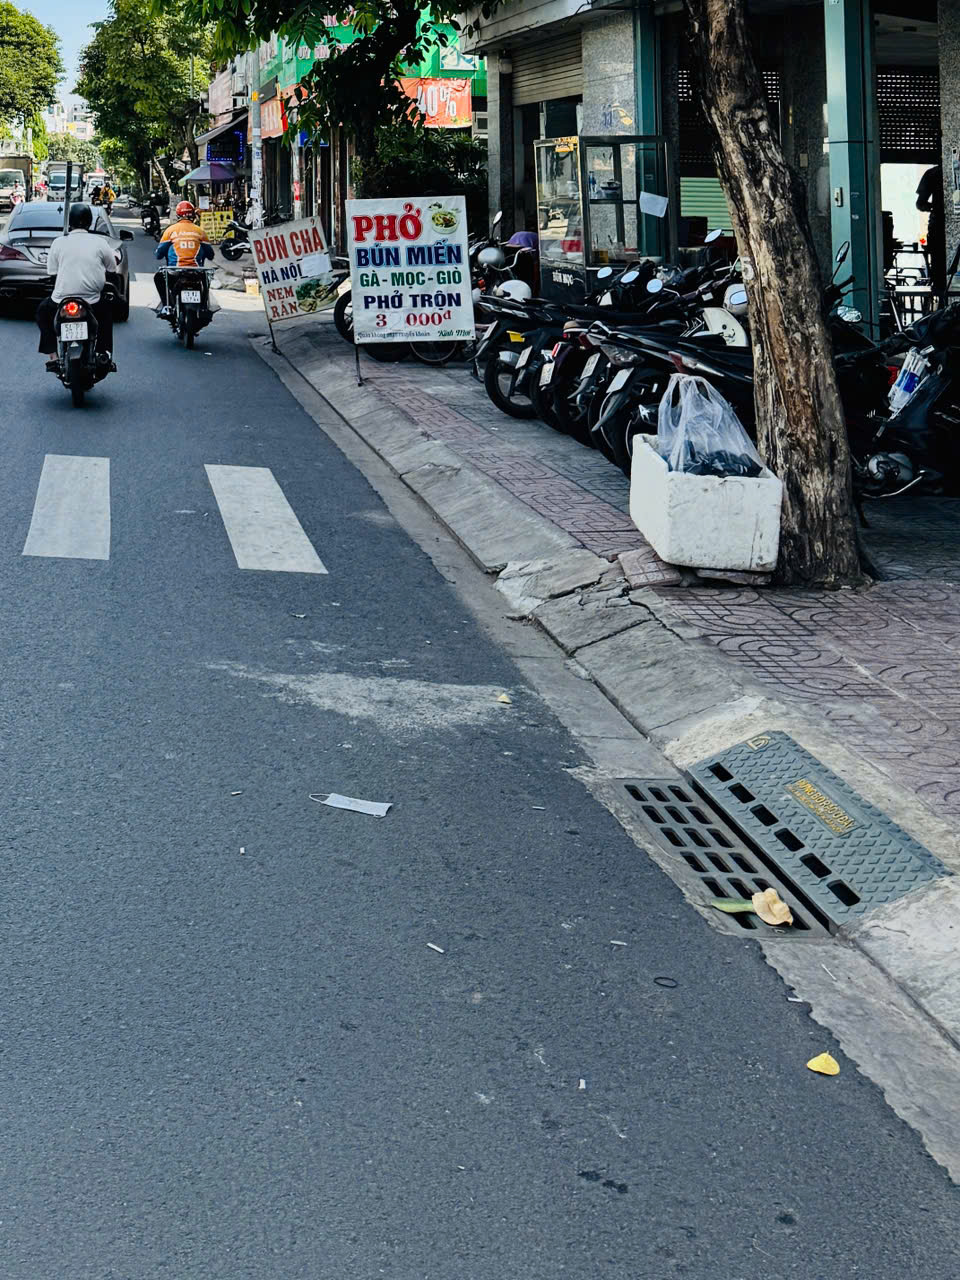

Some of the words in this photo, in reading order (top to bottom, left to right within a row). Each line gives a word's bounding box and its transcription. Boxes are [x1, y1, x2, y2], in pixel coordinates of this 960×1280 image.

[416, 85, 457, 117] 40%
[351, 202, 423, 243] PHỞ
[253, 231, 289, 264] BÚN
[289, 218, 325, 257] CHẢ
[355, 243, 401, 268] BÚN
[405, 238, 463, 266] MIẾN
[262, 266, 279, 285] HÀ
[280, 262, 303, 281] NỘI
[359, 270, 381, 287] GÀ
[391, 271, 426, 289] MỌC
[436, 267, 462, 285] GIÒ
[267, 286, 294, 302] NEM
[363, 290, 403, 309] PHỞ
[409, 291, 462, 311] TRỘN
[271, 301, 299, 318] RÁN
